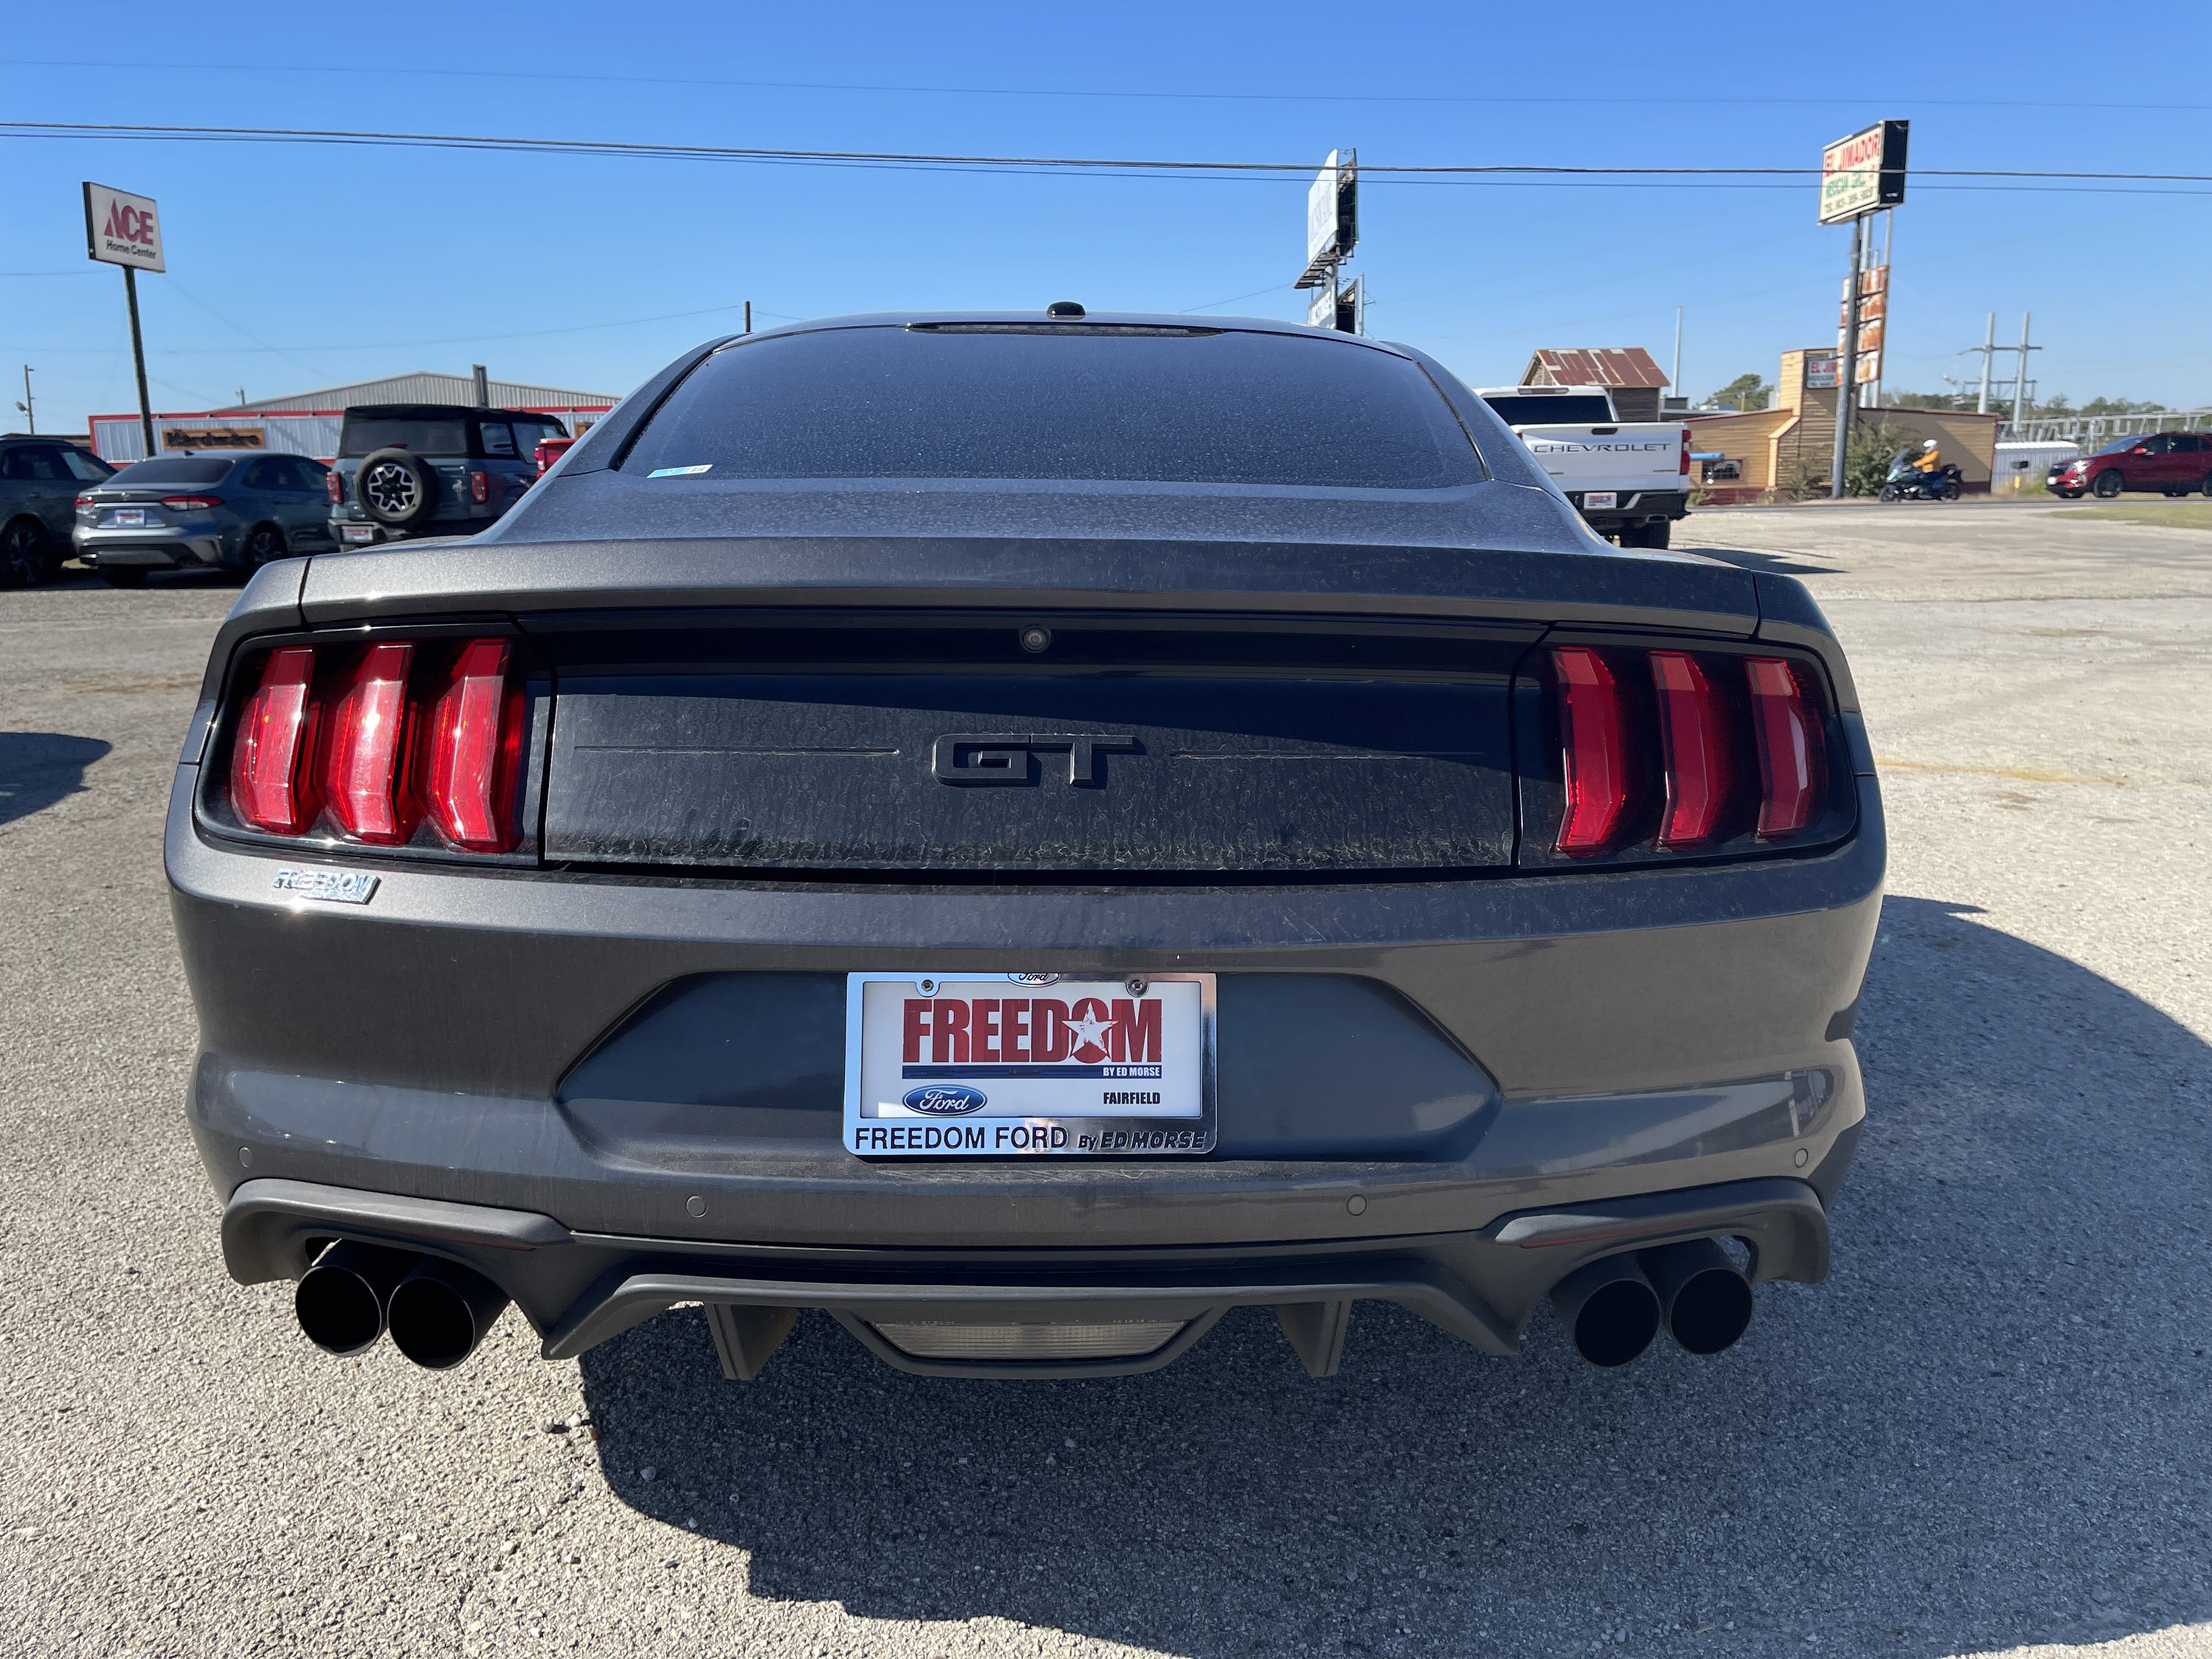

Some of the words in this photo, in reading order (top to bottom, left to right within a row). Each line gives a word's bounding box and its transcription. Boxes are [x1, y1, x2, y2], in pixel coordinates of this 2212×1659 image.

[104, 199, 154, 246] ACE
[106, 240, 129, 254] Home
[131, 245, 157, 259] Center
[1534, 443, 1672, 453] CHEVROLET
[932, 733, 1135, 787] GT
[902, 998, 1162, 1064] FREEDOM
[1103, 1066, 1115, 1076] BY
[1116, 1066, 1127, 1076] ED
[1129, 1066, 1160, 1076] MORSE
[919, 1089, 970, 1110] Ford
[1103, 1092, 1160, 1104] FAIRFIELD
[855, 1126, 985, 1149] FREEDOM
[996, 1126, 1068, 1148] FORD
[1100, 1131, 1128, 1148] ED
[1131, 1131, 1206, 1149] MORSE
